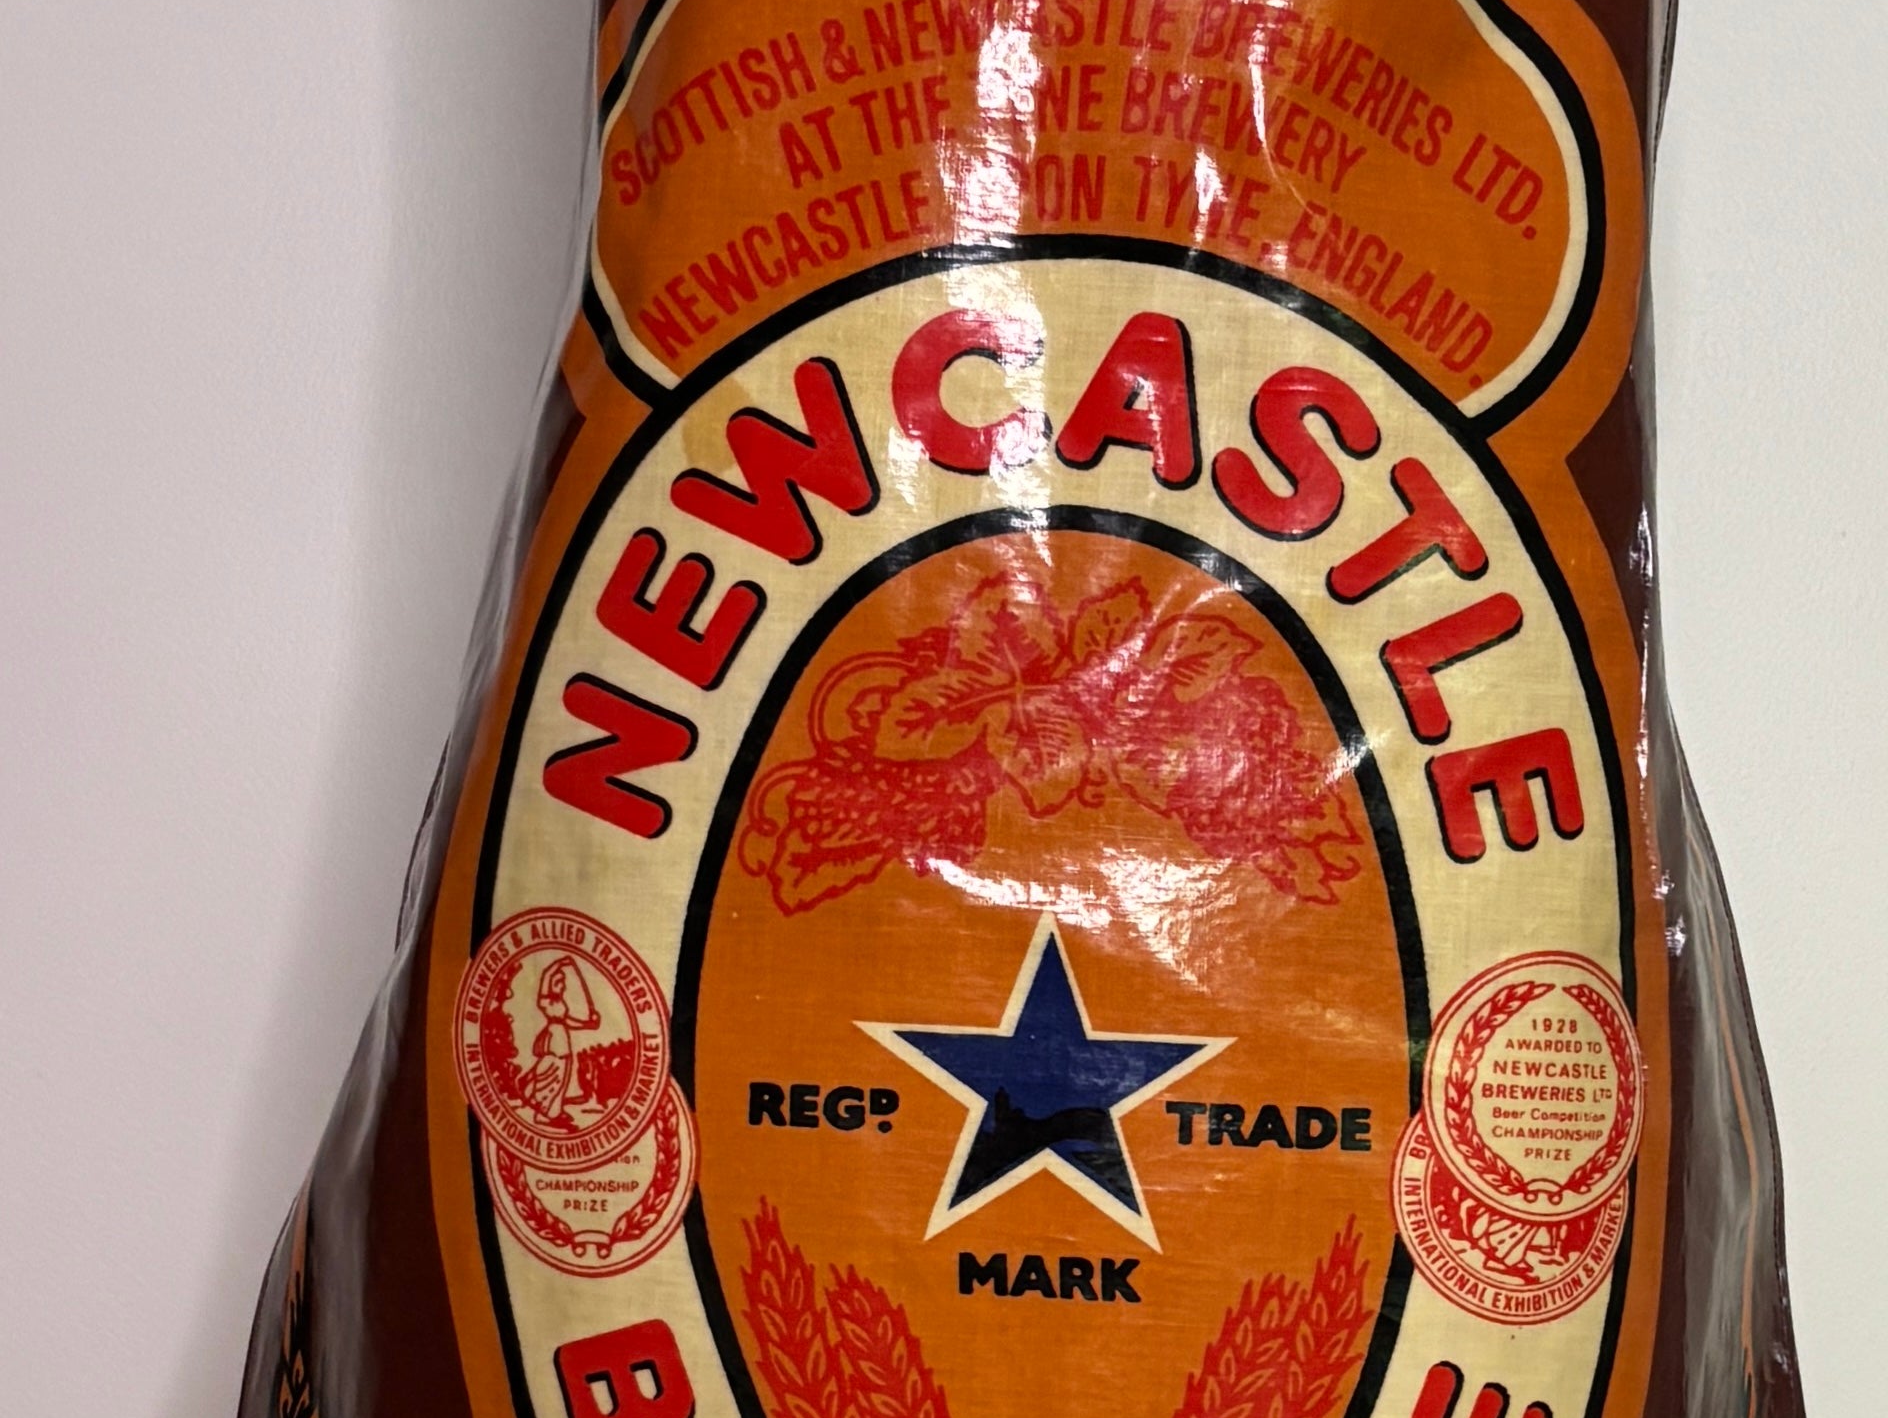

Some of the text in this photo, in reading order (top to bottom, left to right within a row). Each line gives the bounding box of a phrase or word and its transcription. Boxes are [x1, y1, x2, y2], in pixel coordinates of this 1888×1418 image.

[610, 31, 817, 206] SCOTTISH
[820, 18, 865, 83] &
[1452, 132, 1546, 242] LTD.
[777, 63, 1367, 195] AT THE NE BREWERY
[638, 171, 934, 361] NEWCASTLE
[1284, 199, 1496, 389] ENGLAND.
[542, 307, 1585, 865] NEWCASTLE
[465, 920, 652, 1024] BREWERS & ALLIED TRADERS
[1532, 1017, 1578, 1034] 1928
[1505, 1038, 1603, 1055] AWARDED TO
[1492, 1060, 1607, 1080] NEWCASTLE
[466, 1031, 660, 1160] INTERNATIONAL EXHIBITION & MARKET
[1481, 1083, 1586, 1103] BREWERIES
[1165, 1100, 1373, 1152] TRADE
[1492, 1107, 1606, 1123] Beer Competition
[1491, 1125, 1604, 1142] CHAMPIONSHIP
[1524, 1147, 1573, 1161] PRIZE
[535, 1179, 640, 1193] CHAMPIONSHIP
[563, 1198, 608, 1213] PRIZE
[1404, 1177, 1489, 1307] INTERNATIONAL
[1491, 1273, 1585, 1314] EXHIBITION
[1582, 1264, 1596, 1279] &
[957, 1251, 1142, 1304] MARK
